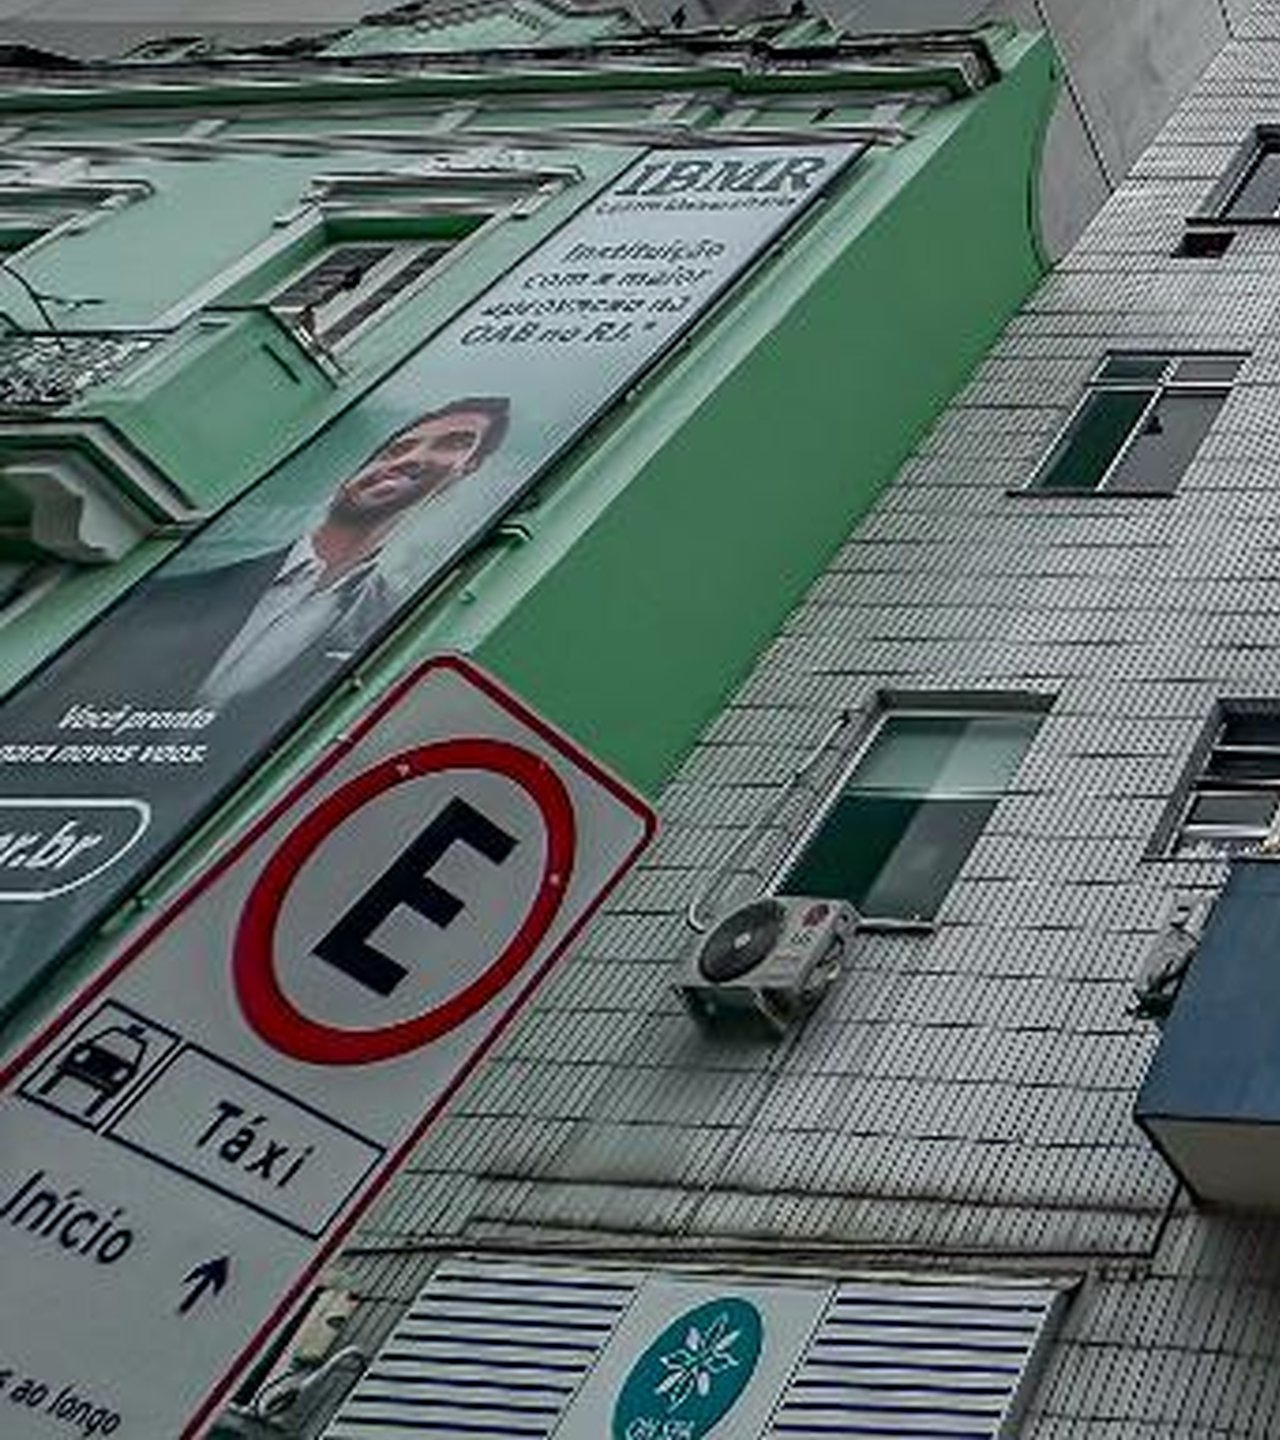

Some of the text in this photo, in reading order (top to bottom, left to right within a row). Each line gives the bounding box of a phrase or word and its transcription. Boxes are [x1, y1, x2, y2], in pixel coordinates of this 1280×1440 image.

[614, 157, 825, 195] IBMR
[562, 239, 726, 263] Instituição
[524, 272, 590, 289] com
[618, 265, 713, 287] maior
[460, 321, 540, 346] OAB
[538, 326, 581, 343] no
[112, 707, 218, 737] pronto
[312, 795, 521, 997] E
[196, 1100, 315, 1189] Táxi
[0, 1170, 133, 1264] Início
[10, 1377, 49, 1408] ao
[47, 1384, 122, 1438] longo
